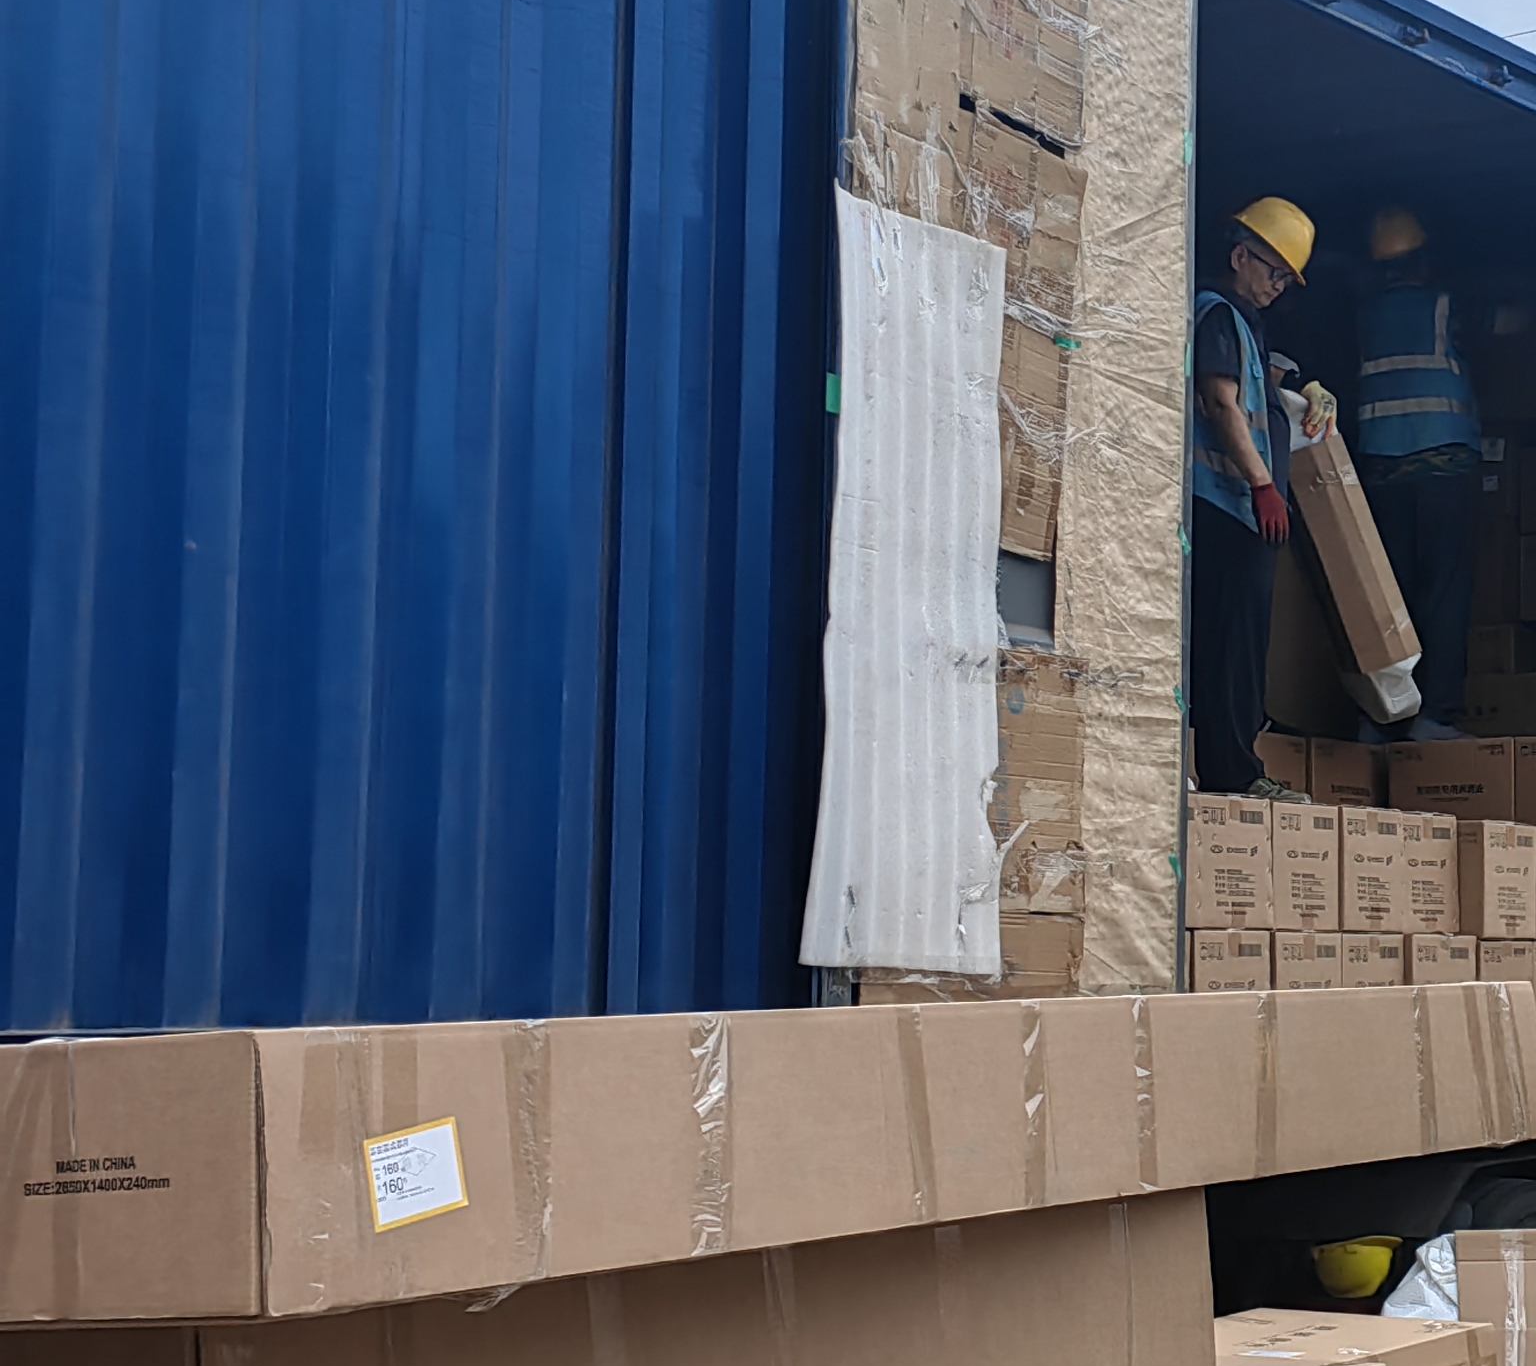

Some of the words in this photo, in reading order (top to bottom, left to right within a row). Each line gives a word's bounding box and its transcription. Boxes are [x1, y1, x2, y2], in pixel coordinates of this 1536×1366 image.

[56, 1159, 87, 1174] MADE
[89, 1158, 100, 1171] IN
[102, 1156, 136, 1171] CHINA
[382, 1176, 404, 1196] 160
